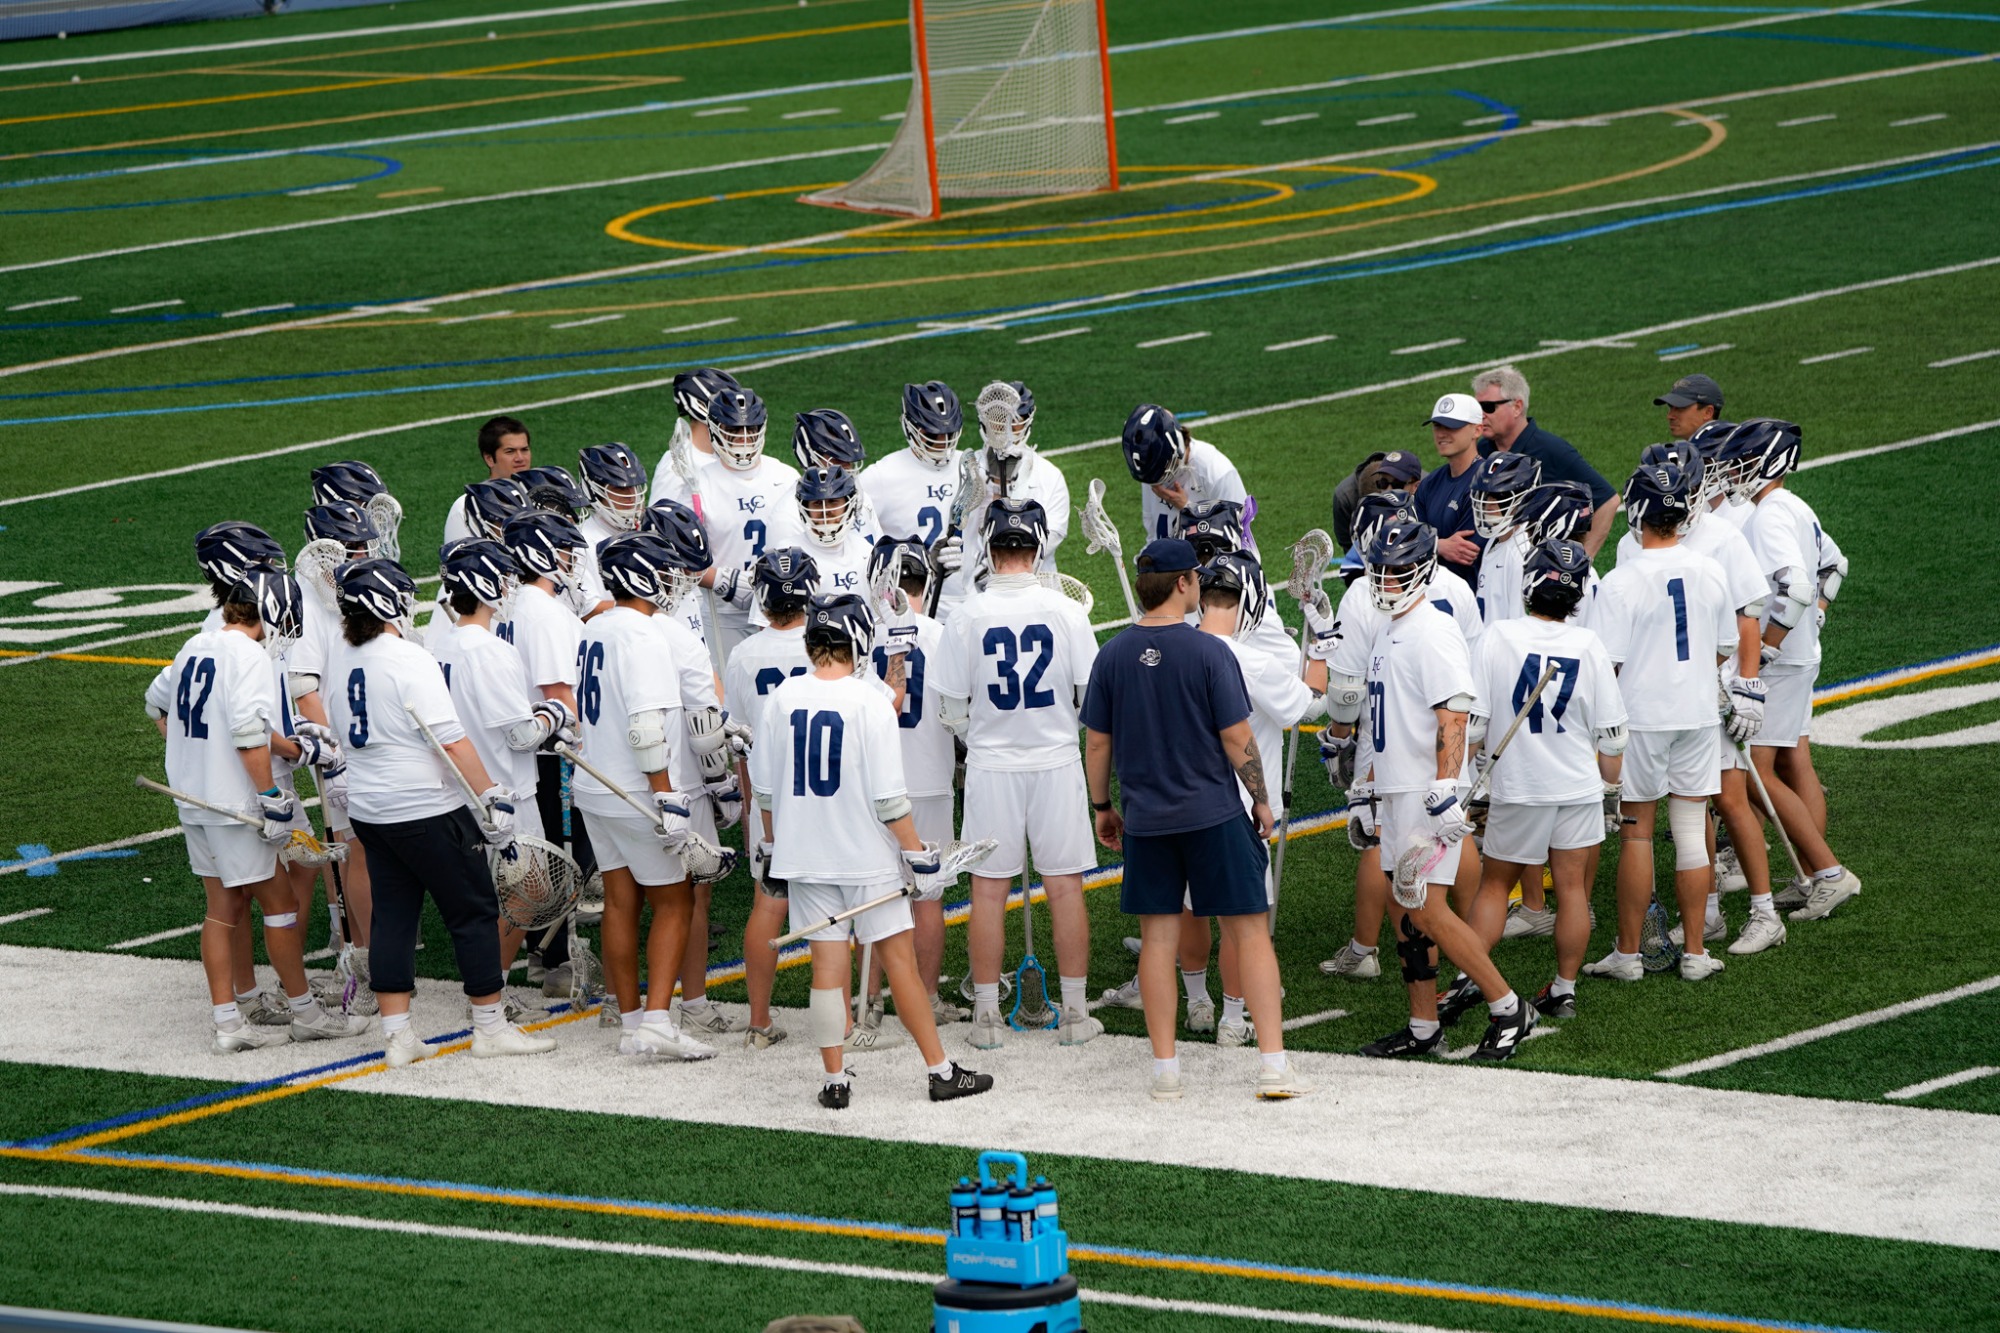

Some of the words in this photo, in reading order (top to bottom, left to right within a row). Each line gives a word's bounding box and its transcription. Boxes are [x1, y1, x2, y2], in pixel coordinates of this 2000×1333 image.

[736, 494, 766, 515] LVC
[833, 570, 859, 591] LVC
[1666, 577, 1690, 662] 1
[176, 655, 216, 740] 42
[346, 667, 371, 749] 9
[982, 624, 1056, 711] 32
[1511, 653, 1581, 735] 47
[789, 708, 845, 798] 10
